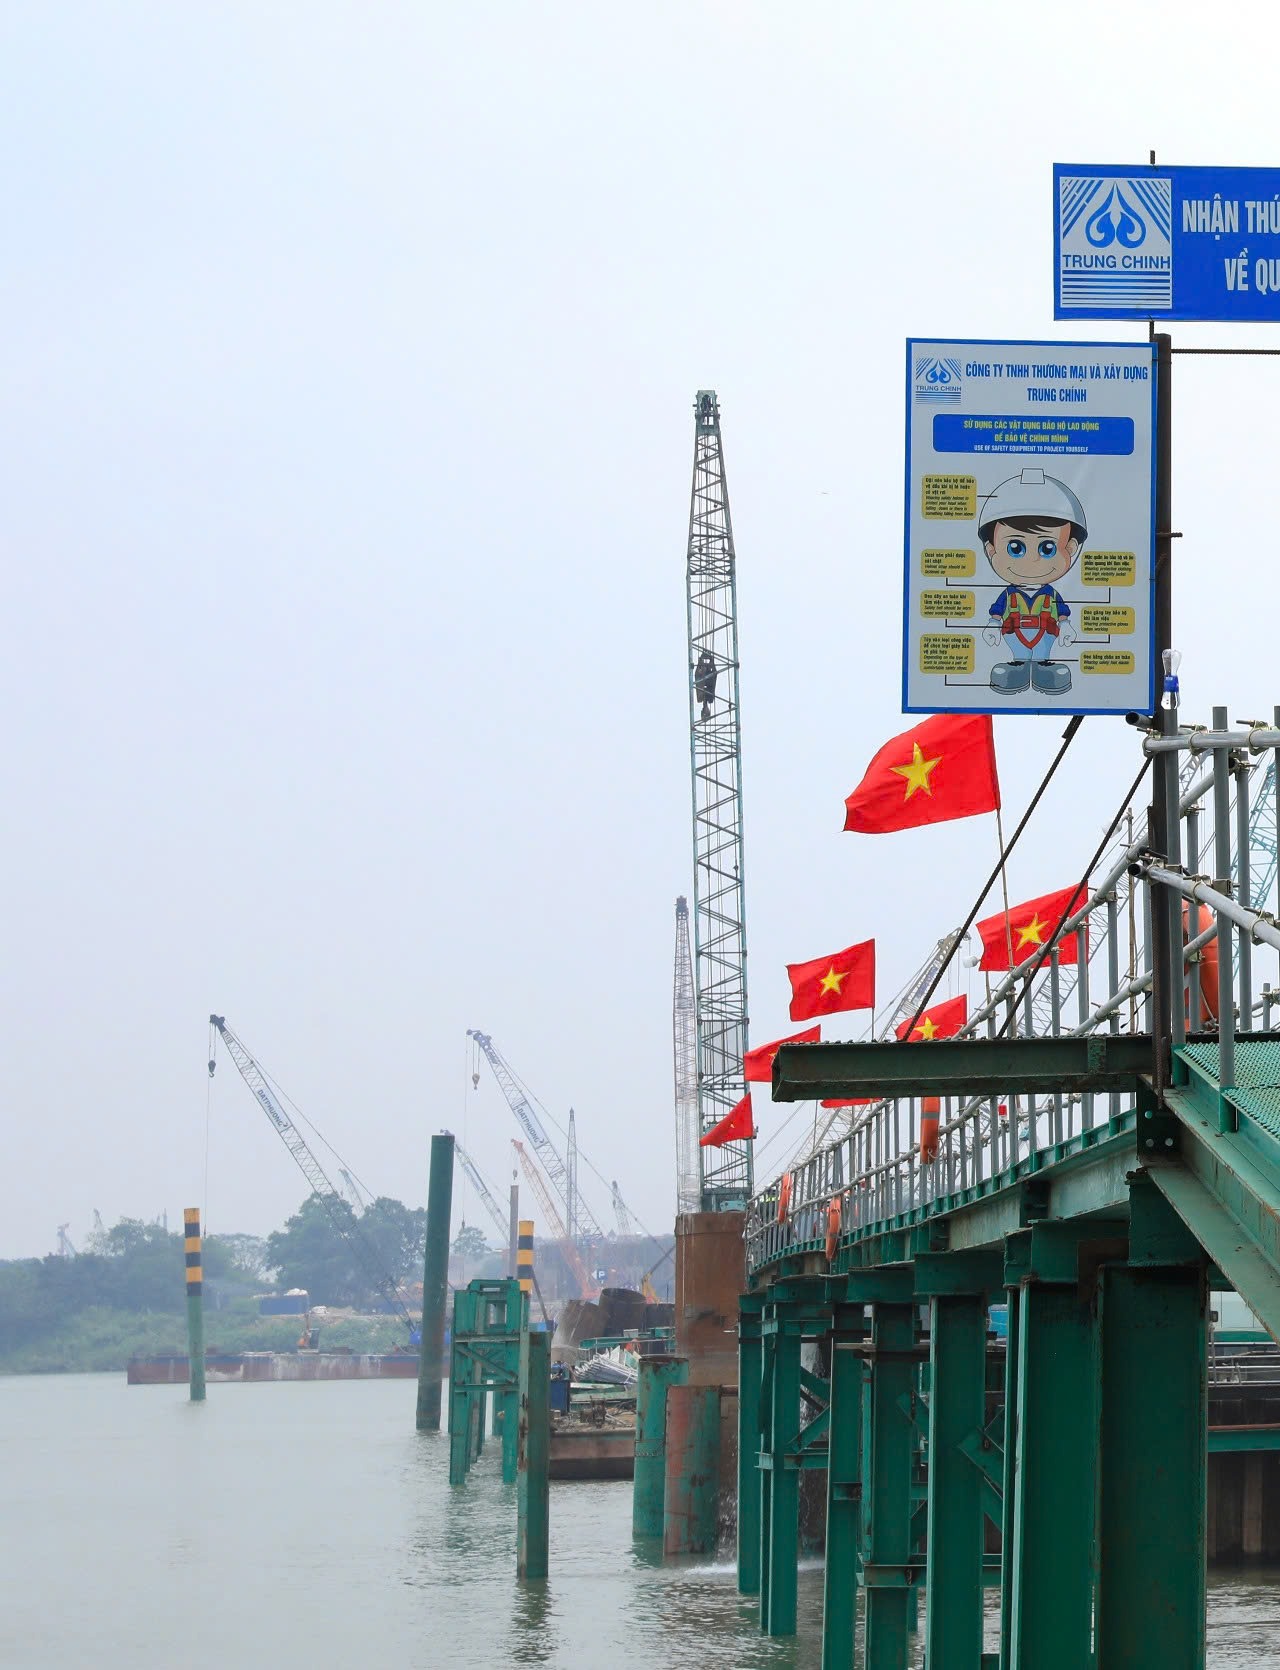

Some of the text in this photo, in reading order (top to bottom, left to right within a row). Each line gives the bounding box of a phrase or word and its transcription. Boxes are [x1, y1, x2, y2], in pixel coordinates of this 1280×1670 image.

[1183, 196, 1238, 240] NHẬN
[1062, 253, 1171, 269] TRUNG CHINH
[1225, 248, 1248, 290] VỀ
[966, 361, 1148, 383] CÔNG TY TNHH THƯƠNG MẠI VÀ XÂY DỰNG
[1027, 385, 1087, 402] TRUNG CHÍNH
[994, 419, 1008, 429] CÁC
[1067, 422, 1080, 430] LAO
